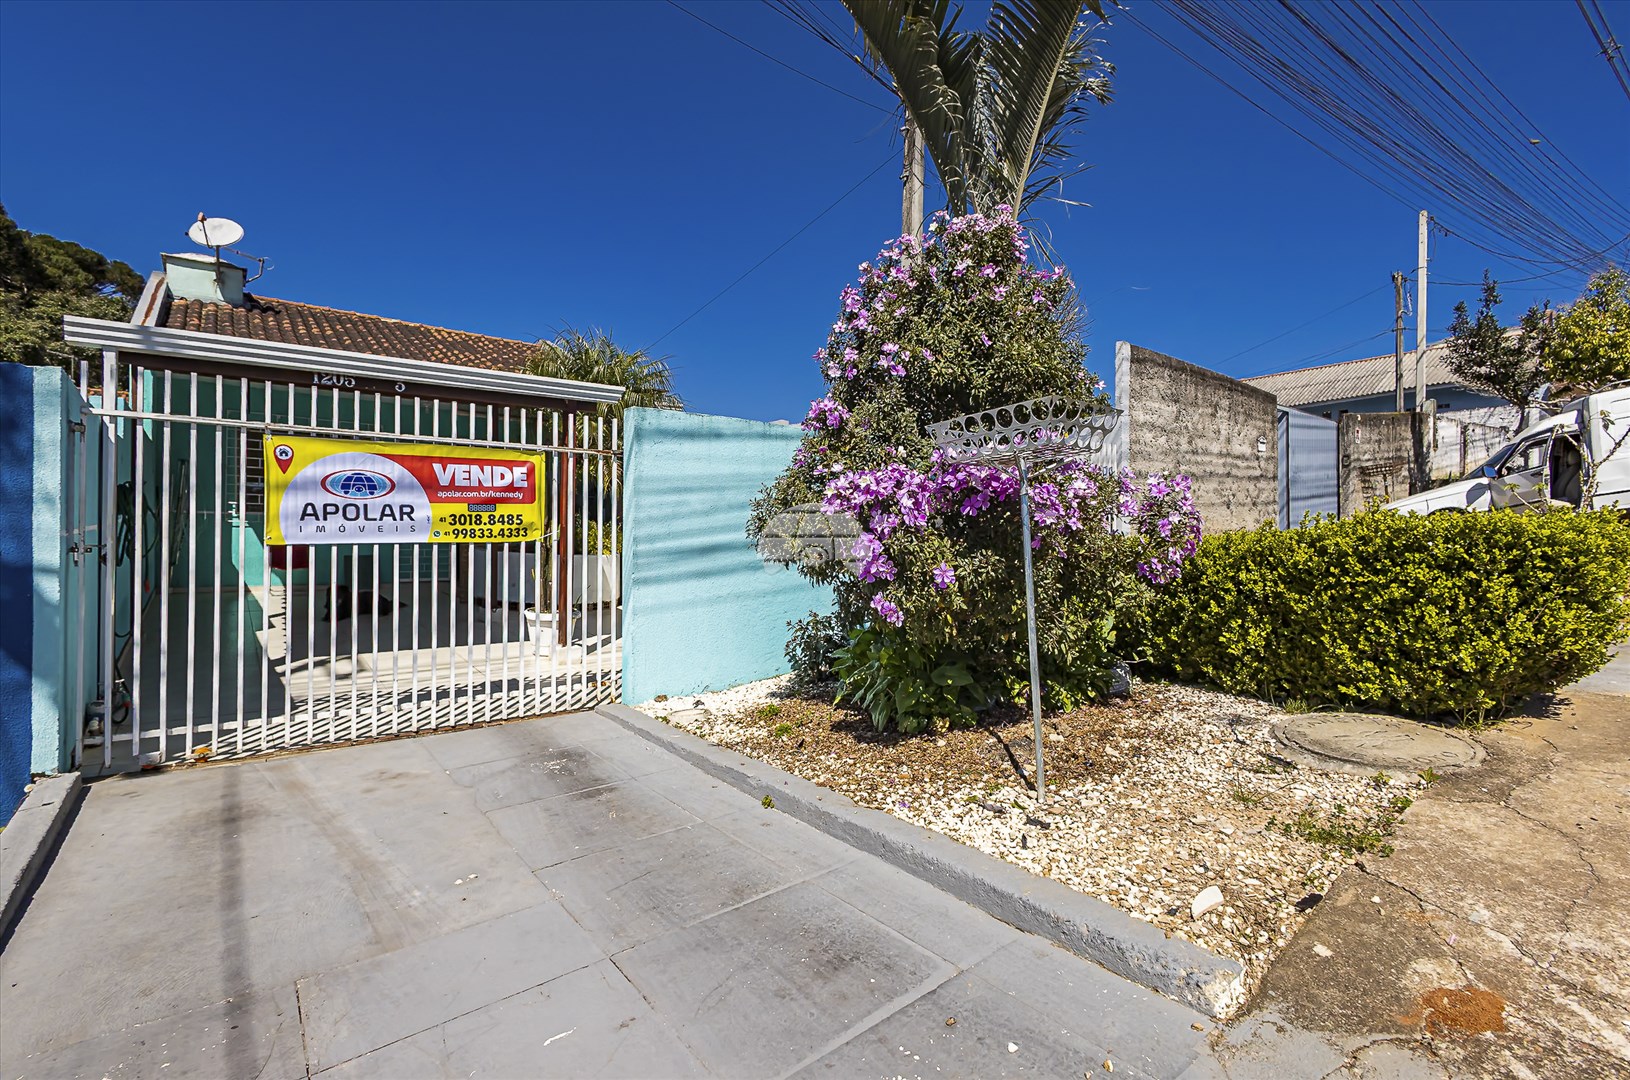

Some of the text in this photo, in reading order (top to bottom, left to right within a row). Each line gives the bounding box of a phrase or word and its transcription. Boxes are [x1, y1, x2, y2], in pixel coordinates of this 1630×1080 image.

[312, 373, 355, 388] 1205
[432, 463, 528, 488] VENDE
[437, 490, 523, 500] apolar.com.br/kennedy
[299, 502, 415, 522] APOLAR
[448, 514, 524, 526] 3018.8485
[452, 527, 528, 539] 99833.4333
